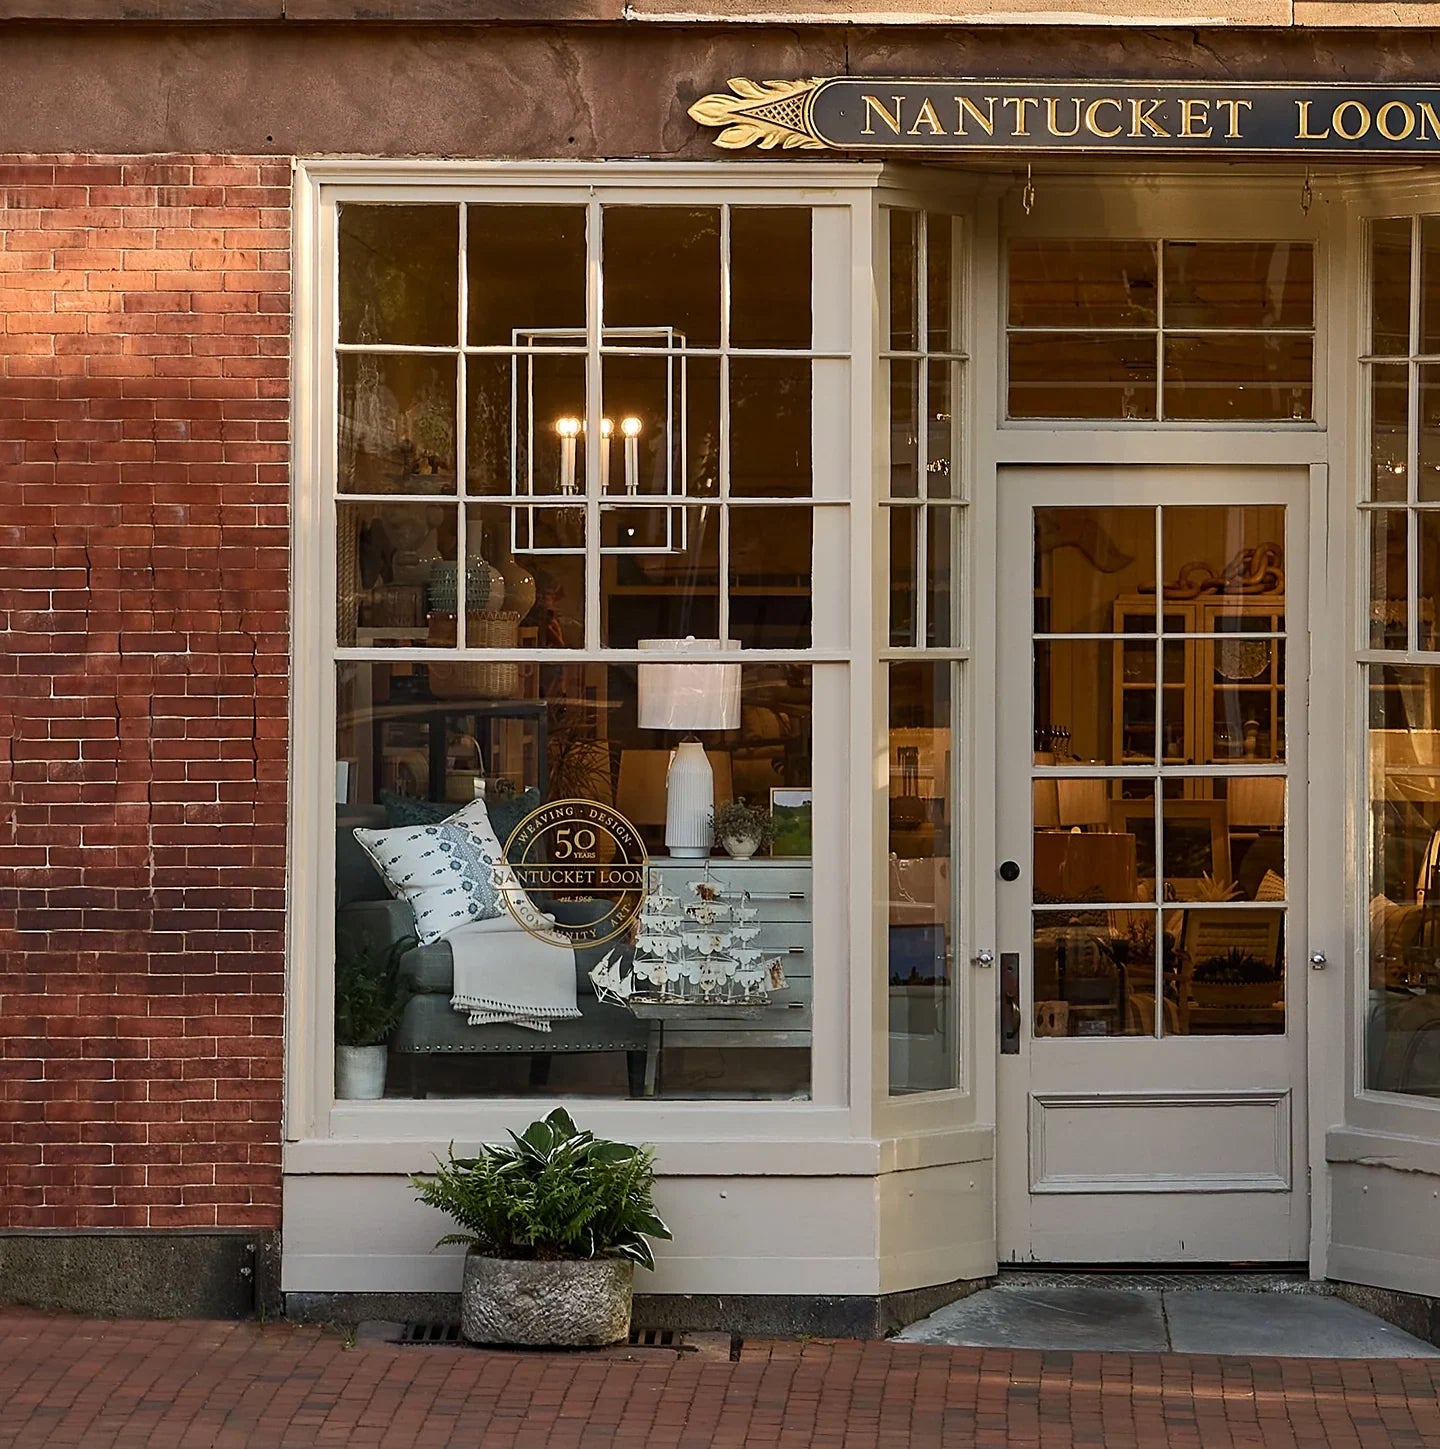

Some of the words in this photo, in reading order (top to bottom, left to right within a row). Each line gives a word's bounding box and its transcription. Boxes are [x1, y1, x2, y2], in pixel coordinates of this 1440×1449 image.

[860, 94, 1252, 138] NANTUCKET
[518, 806, 574, 843] WEAVING
[589, 809, 632, 844] DESIGN
[555, 828, 596, 859] 50
[573, 851, 596, 859] YEARS
[493, 870, 595, 884] NANTUCKET
[610, 904, 630, 928] ART
